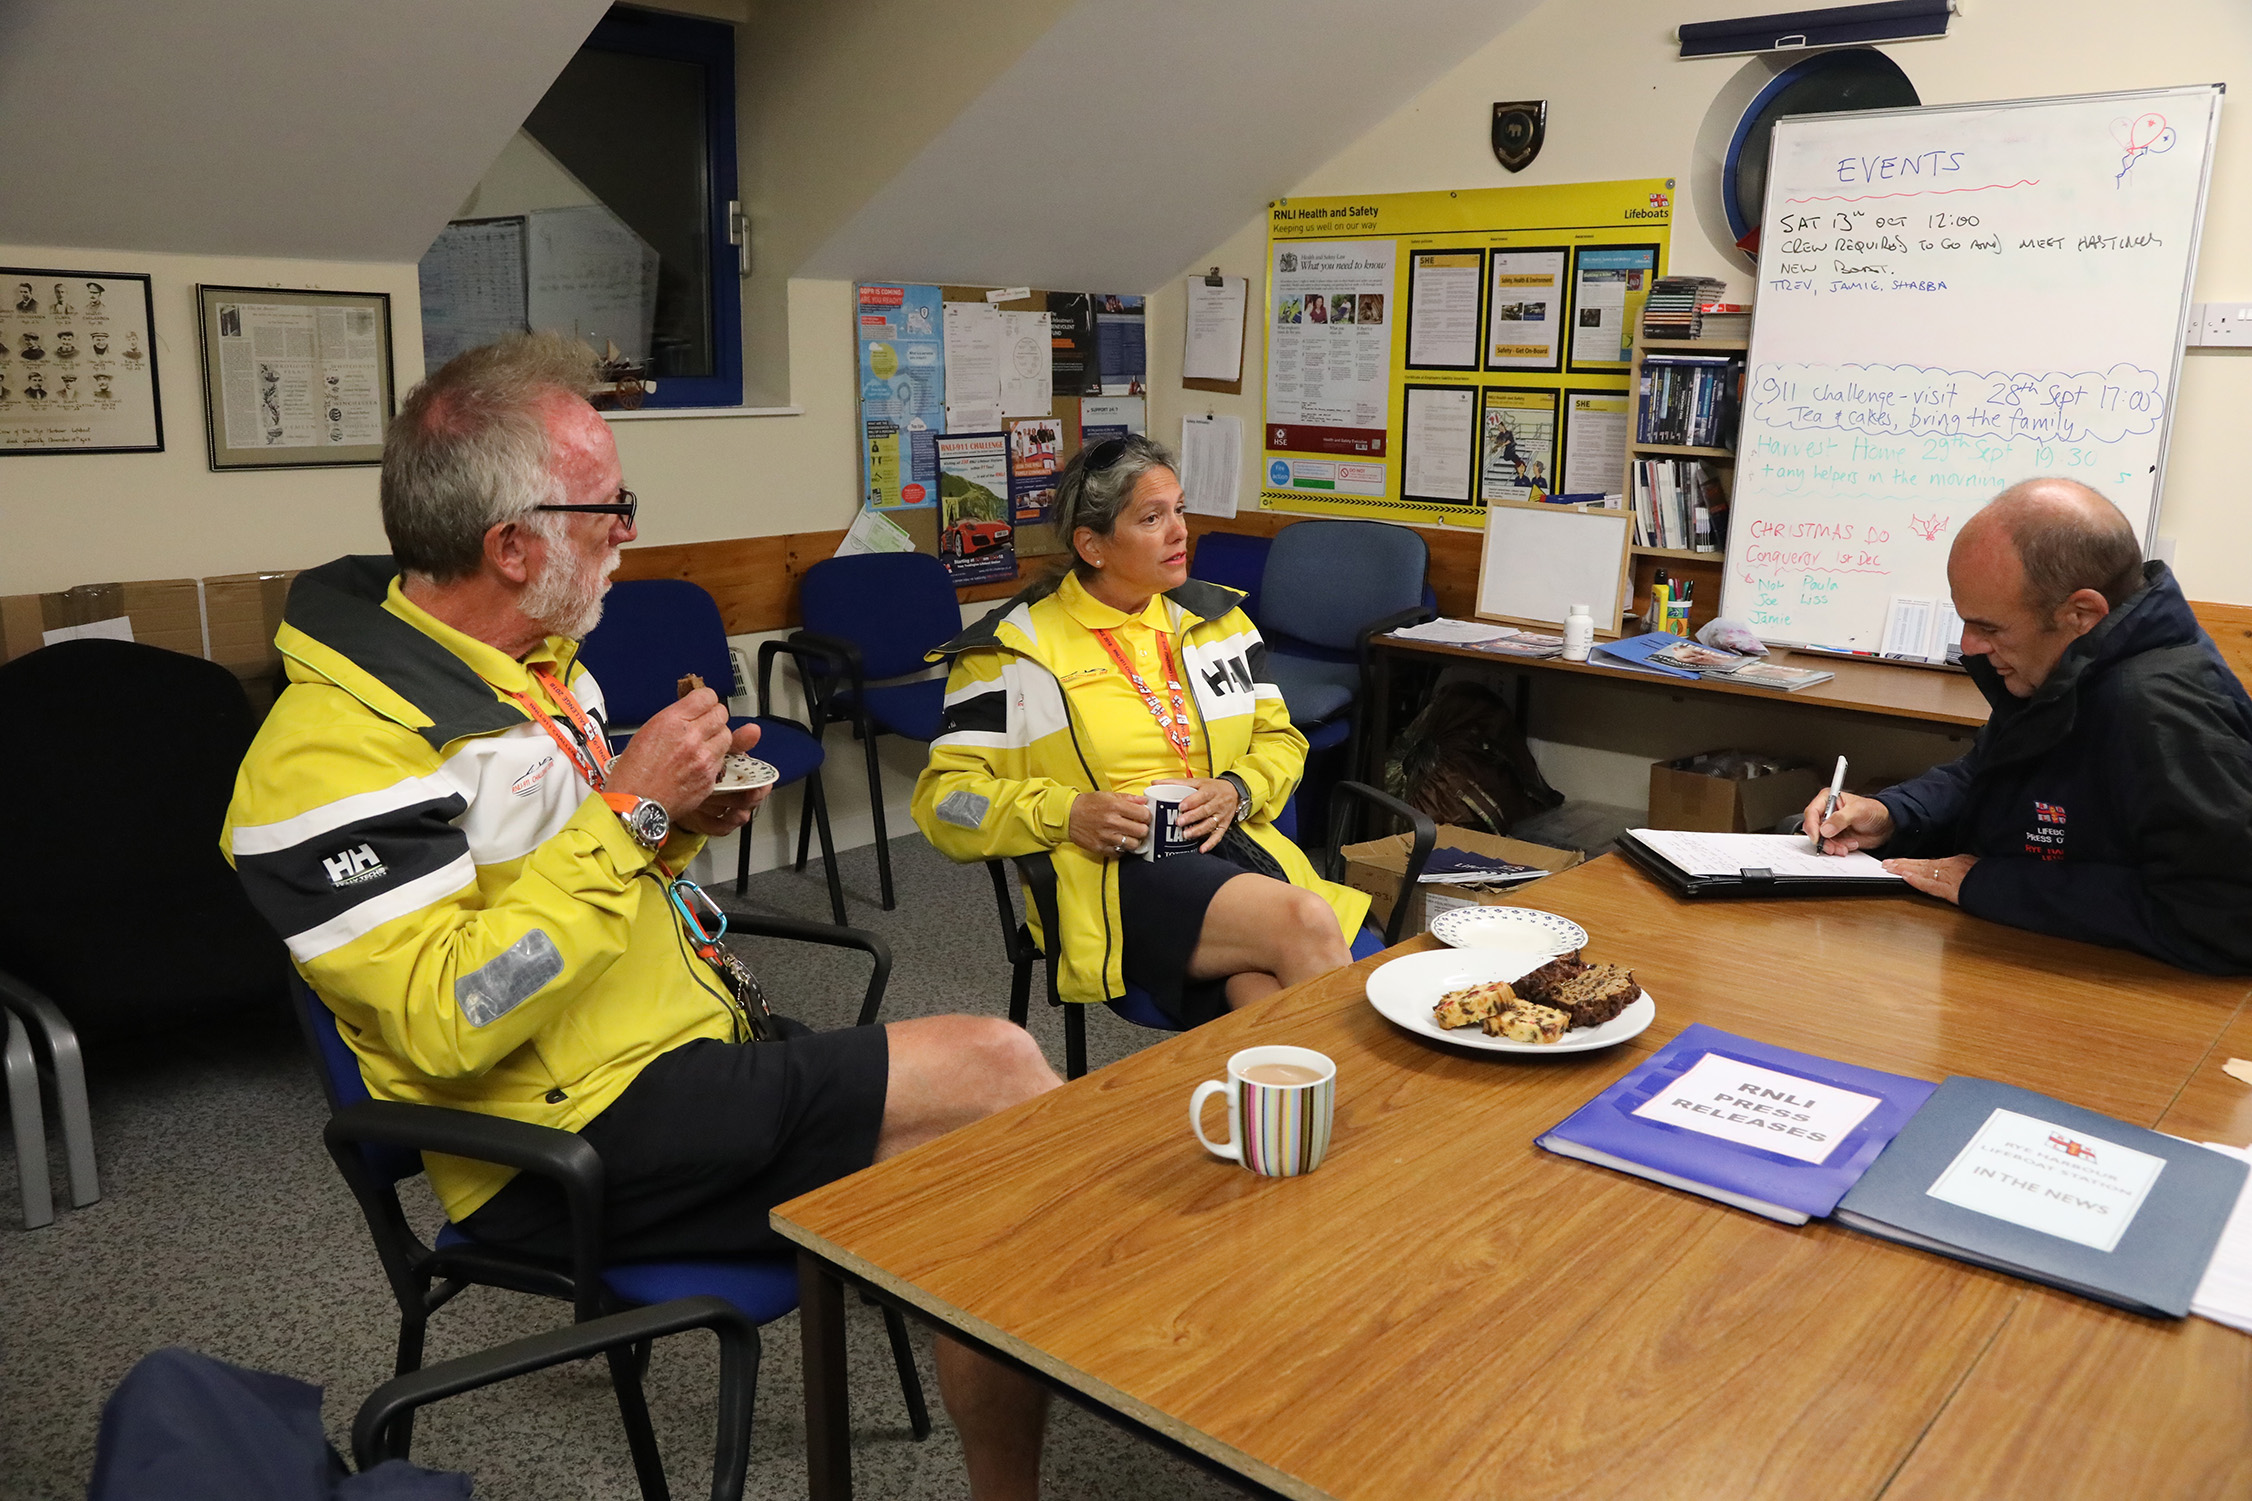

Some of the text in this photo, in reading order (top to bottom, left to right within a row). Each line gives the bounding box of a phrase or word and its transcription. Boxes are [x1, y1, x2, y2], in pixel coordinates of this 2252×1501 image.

[1837, 150, 1965, 183] EVENTS
[1274, 206, 1379, 220] RNLI Health and Safety
[1624, 209, 1669, 219] Lifeboats
[1273, 224, 1304, 234] Keeping
[1317, 222, 1333, 231] well
[1361, 222, 1377, 230] way
[1780, 213, 1821, 233] SAT
[1876, 217, 1908, 228] OCT
[1928, 212, 1980, 229] 12:00
[1781, 238, 1827, 254] CREW
[1919, 239, 1934, 250] TO
[1941, 238, 1961, 250] GO
[2019, 237, 2065, 250] MEET
[1300, 259, 1387, 273] What you need to know
[1420, 256, 1435, 265] SHE
[1780, 263, 1817, 275] NEW
[1891, 280, 1948, 292] SHABBA
[1763, 377, 1797, 405] 911
[2040, 384, 2089, 412] Sept
[1575, 400, 1590, 408] SHE
[1787, 406, 1822, 422] Tea
[1849, 407, 1898, 430] cakes,
[1910, 407, 1961, 435] bring
[1967, 407, 2001, 428] the
[2009, 408, 2074, 441] family
[970, 441, 1003, 450] CHALLENGE
[1273, 438, 1288, 446] HSE
[1758, 434, 1838, 459] Harvest
[1852, 436, 1906, 463] Home
[1968, 439, 2013, 470] Sept
[1814, 465, 1858, 488] helpers
[1868, 471, 1884, 483] in
[1892, 468, 1918, 487] the
[1930, 472, 2006, 489] morning
[1750, 520, 1890, 544] CHRISTMAS DO
[1857, 550, 1881, 566] Dec
[1802, 575, 1839, 592] Paula
[1754, 593, 1778, 606] Joe
[1748, 610, 1792, 625] Jamie
[550, 682, 564, 696] 2018
[530, 703, 552, 728] RNLI-911
[2026, 832, 2052, 843] PRESS
[322, 843, 381, 882] HH
[1738, 1083, 1817, 1109] RNLI
[1714, 1093, 1812, 1122] PRESS
[1672, 1098, 1828, 1142] RELEASES
[2004, 1141, 2119, 1182] RYE HARBOUR
[1980, 1145, 2133, 1197] LIFEBOAT STATION
[1973, 1165, 2111, 1216] IN THE NEWS
